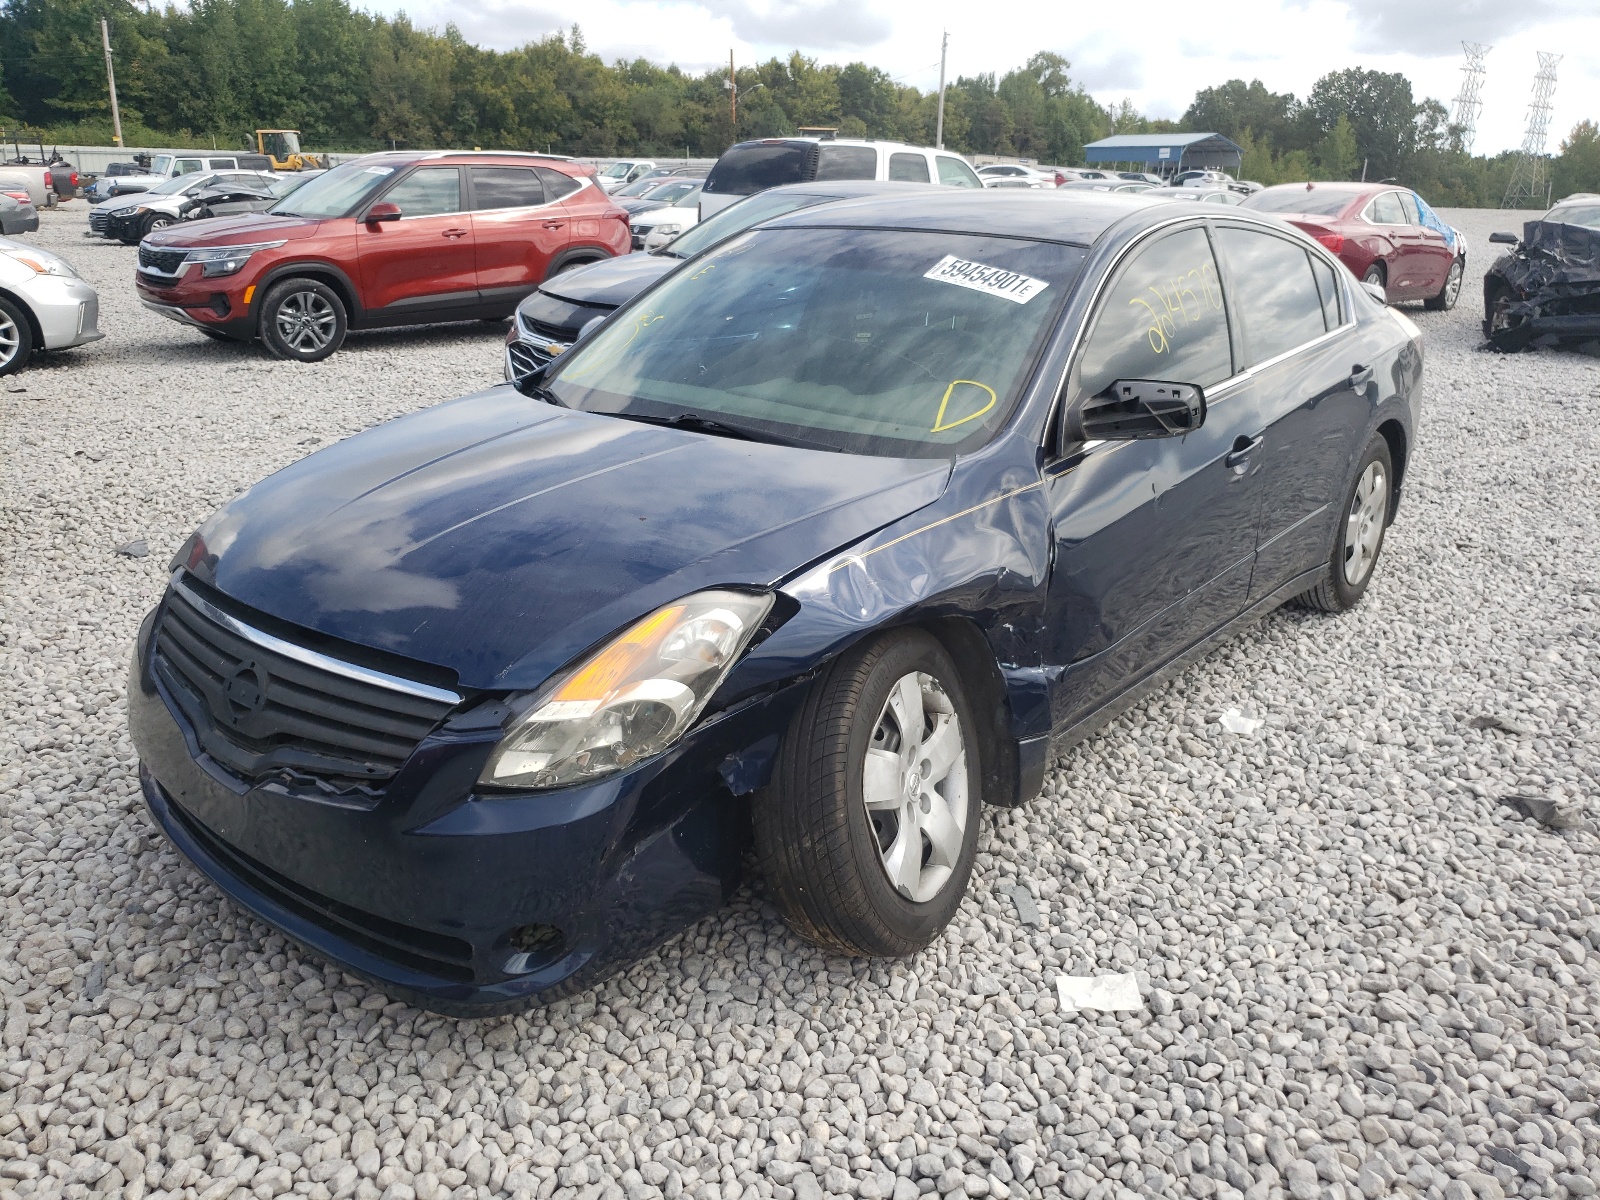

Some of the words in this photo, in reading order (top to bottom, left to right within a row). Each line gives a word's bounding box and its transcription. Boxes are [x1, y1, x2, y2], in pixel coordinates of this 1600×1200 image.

[941, 260, 1030, 293] 59454901
[1020, 285, 1032, 295] E
[930, 380, 997, 433] D
